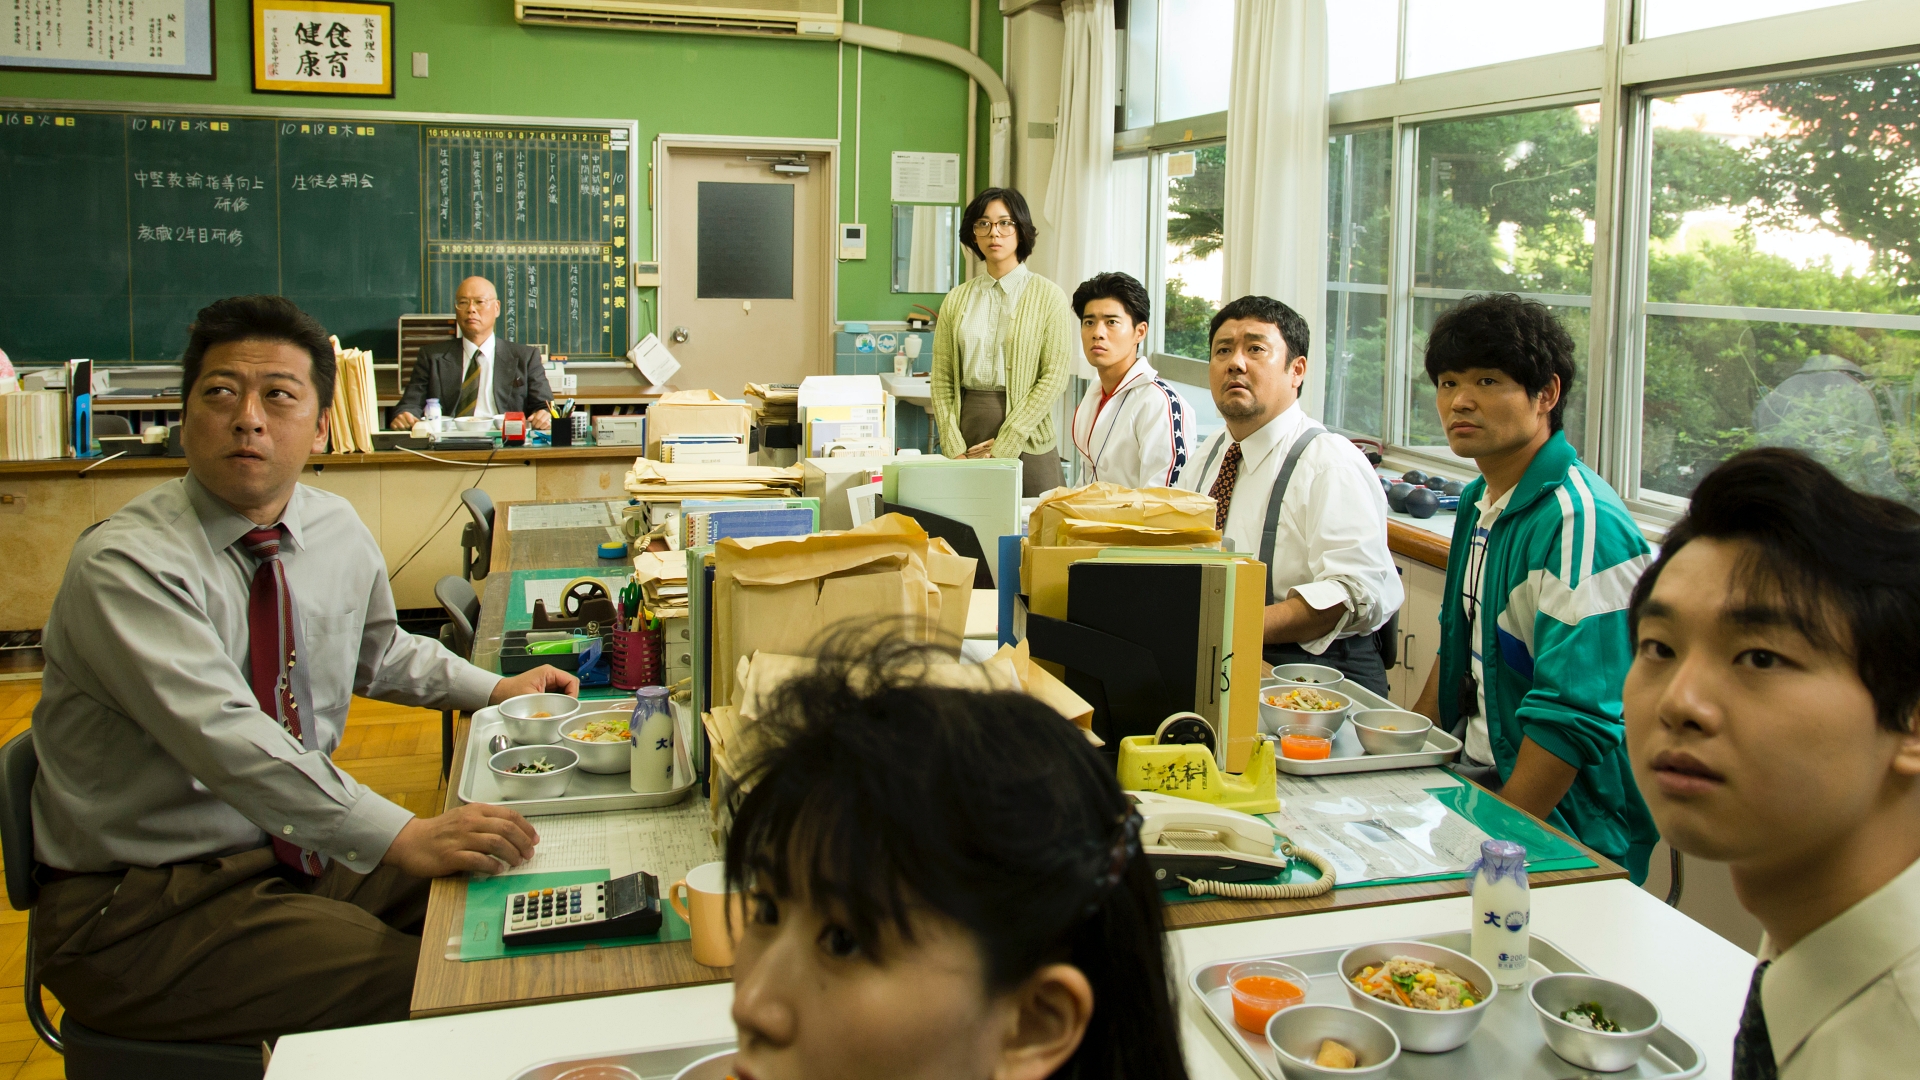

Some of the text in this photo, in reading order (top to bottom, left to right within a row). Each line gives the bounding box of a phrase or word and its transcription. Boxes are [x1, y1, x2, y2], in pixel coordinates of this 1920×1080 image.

[295, 21, 324, 77] 健康
[325, 21, 352, 78] 食育
[364, 17, 375, 63] 教育理念
[0, 113, 75, 127] 16日火日
[291, 172, 375, 191] 生徒会朝会
[494, 150, 504, 193] 体育の日
[548, 152, 558, 204] PTA会議
[580, 154, 590, 195] 中間試験
[592, 154, 600, 197] 中間試験
[213, 196, 249, 213] 研修
[137, 222, 244, 247] 教職2年目研修
[656, 738, 668, 750] 大
[1484, 911, 1501, 928] 大
